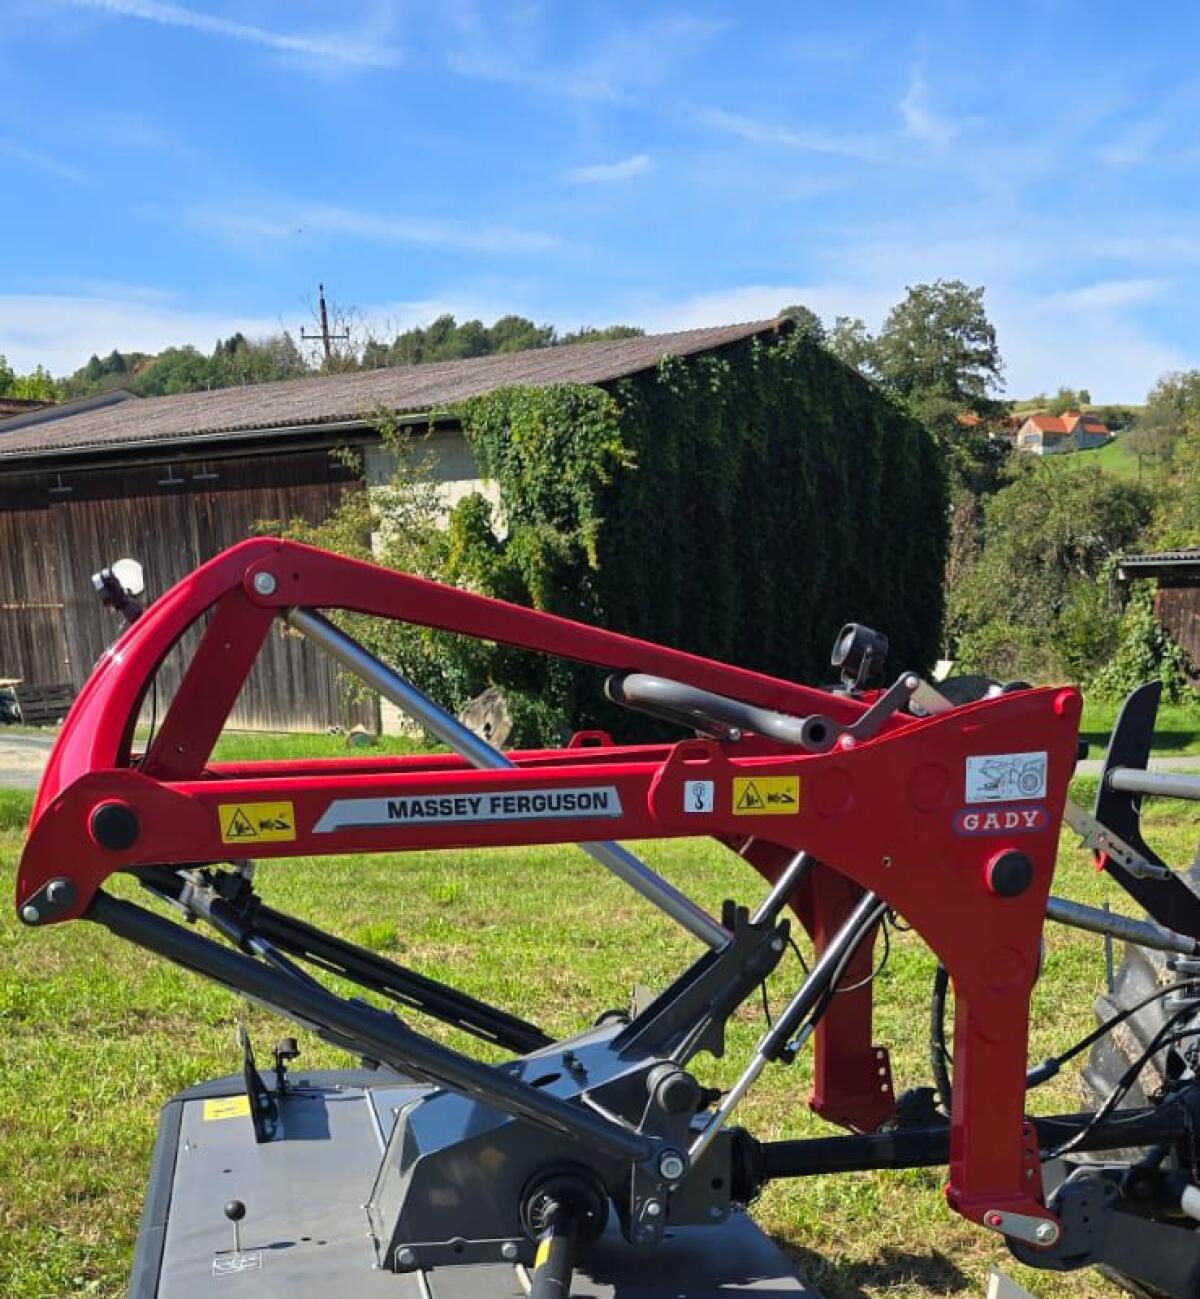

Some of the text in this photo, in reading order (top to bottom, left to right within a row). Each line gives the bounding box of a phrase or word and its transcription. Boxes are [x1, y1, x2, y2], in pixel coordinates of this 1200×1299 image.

[387, 791, 608, 819] MASSEY FERGUSON
[963, 811, 1040, 831] GADY
